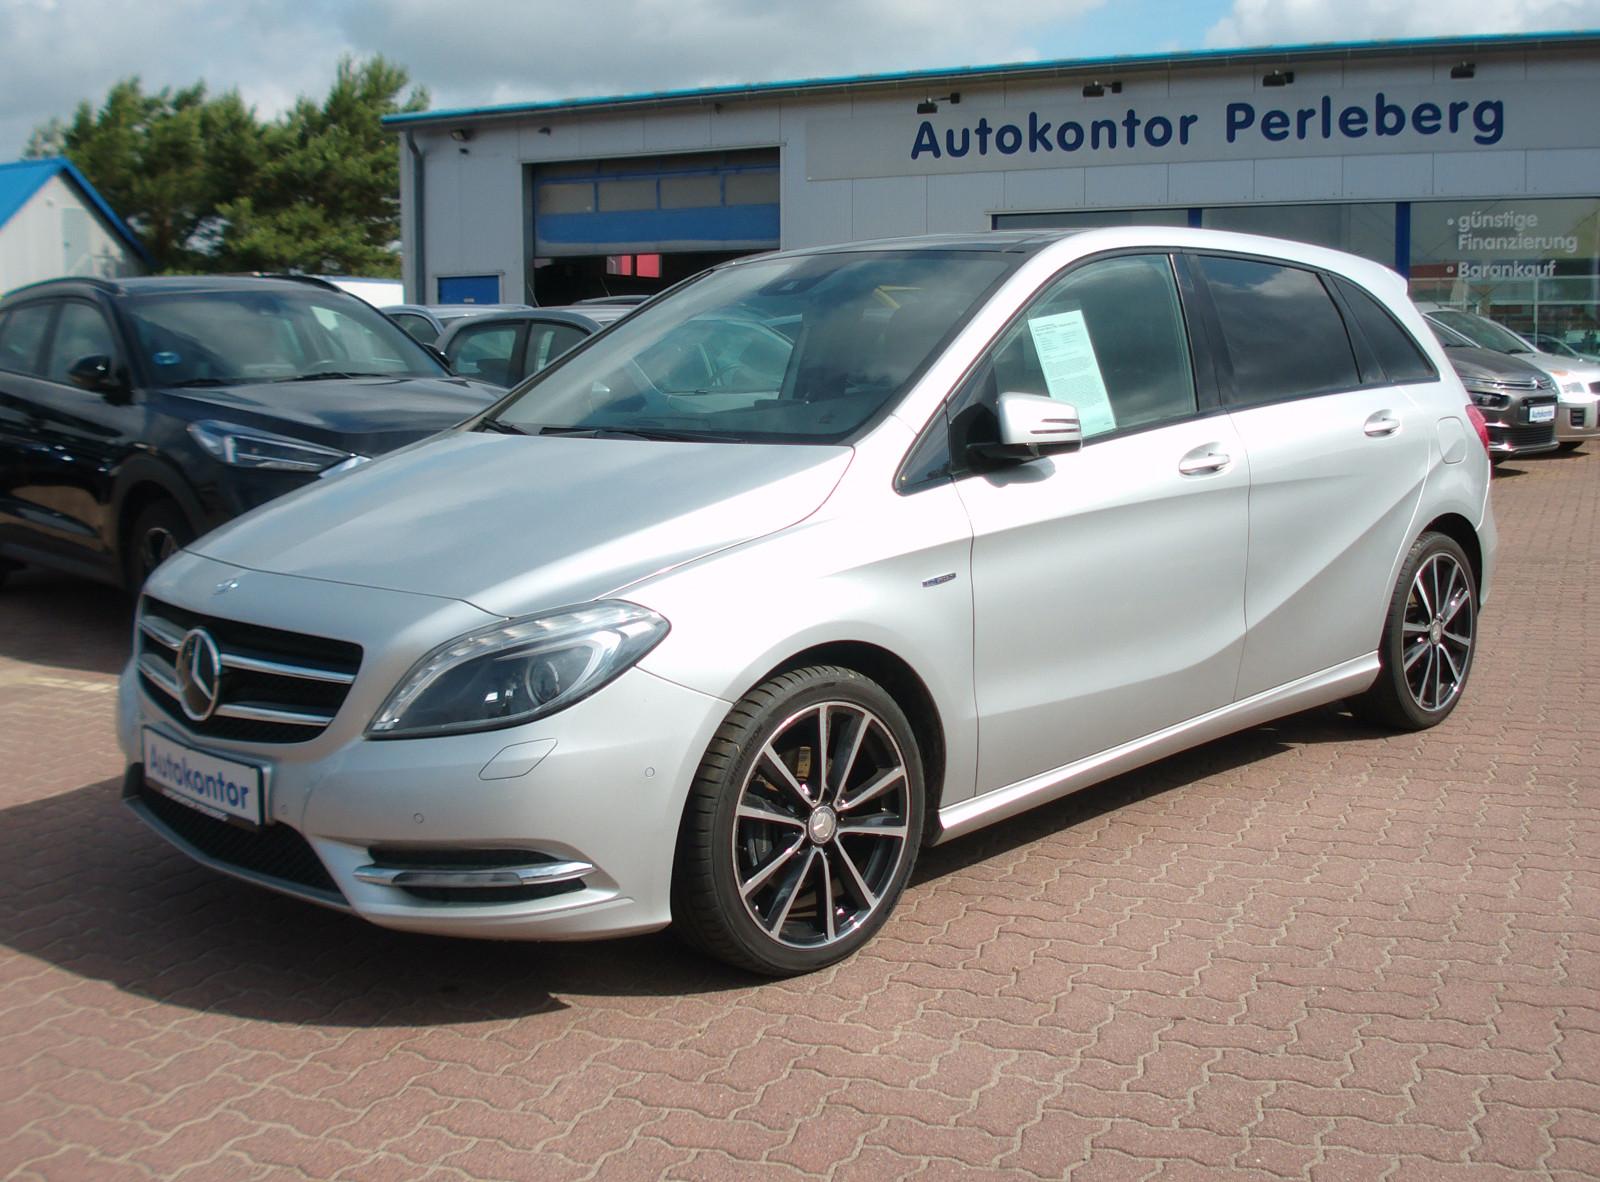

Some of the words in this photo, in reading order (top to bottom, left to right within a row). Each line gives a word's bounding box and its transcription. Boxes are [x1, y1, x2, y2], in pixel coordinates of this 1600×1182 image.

[911, 108, 1198, 160] Autokontor
[1226, 92, 1504, 145] Perleberg
[1458, 210, 1538, 231] günstige
[1458, 233, 1578, 253] Finanzierung
[1458, 259, 1556, 279] Barankauf
[150, 744, 249, 809] Autokontor
